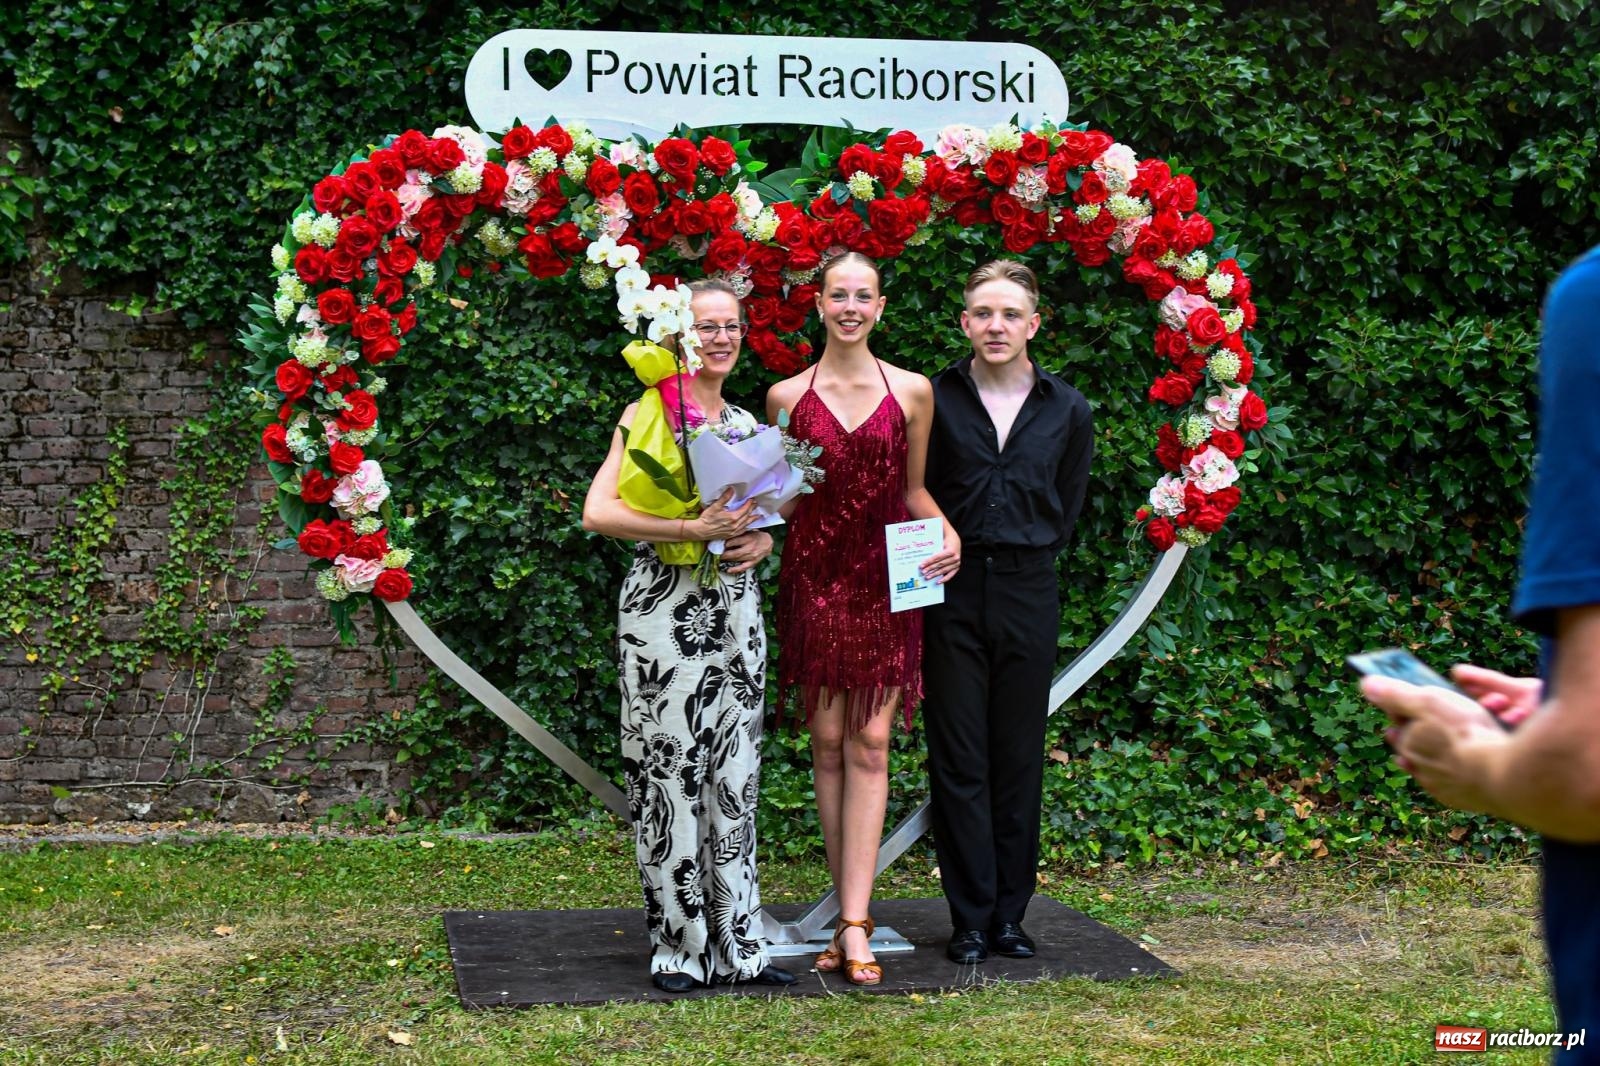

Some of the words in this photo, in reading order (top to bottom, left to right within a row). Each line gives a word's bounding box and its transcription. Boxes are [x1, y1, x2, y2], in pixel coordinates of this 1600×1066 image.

[503, 47, 510, 91] I
[587, 49, 759, 98] Powiat
[778, 54, 1036, 103] Raciborski
[898, 524, 926, 535] DYPLOM
